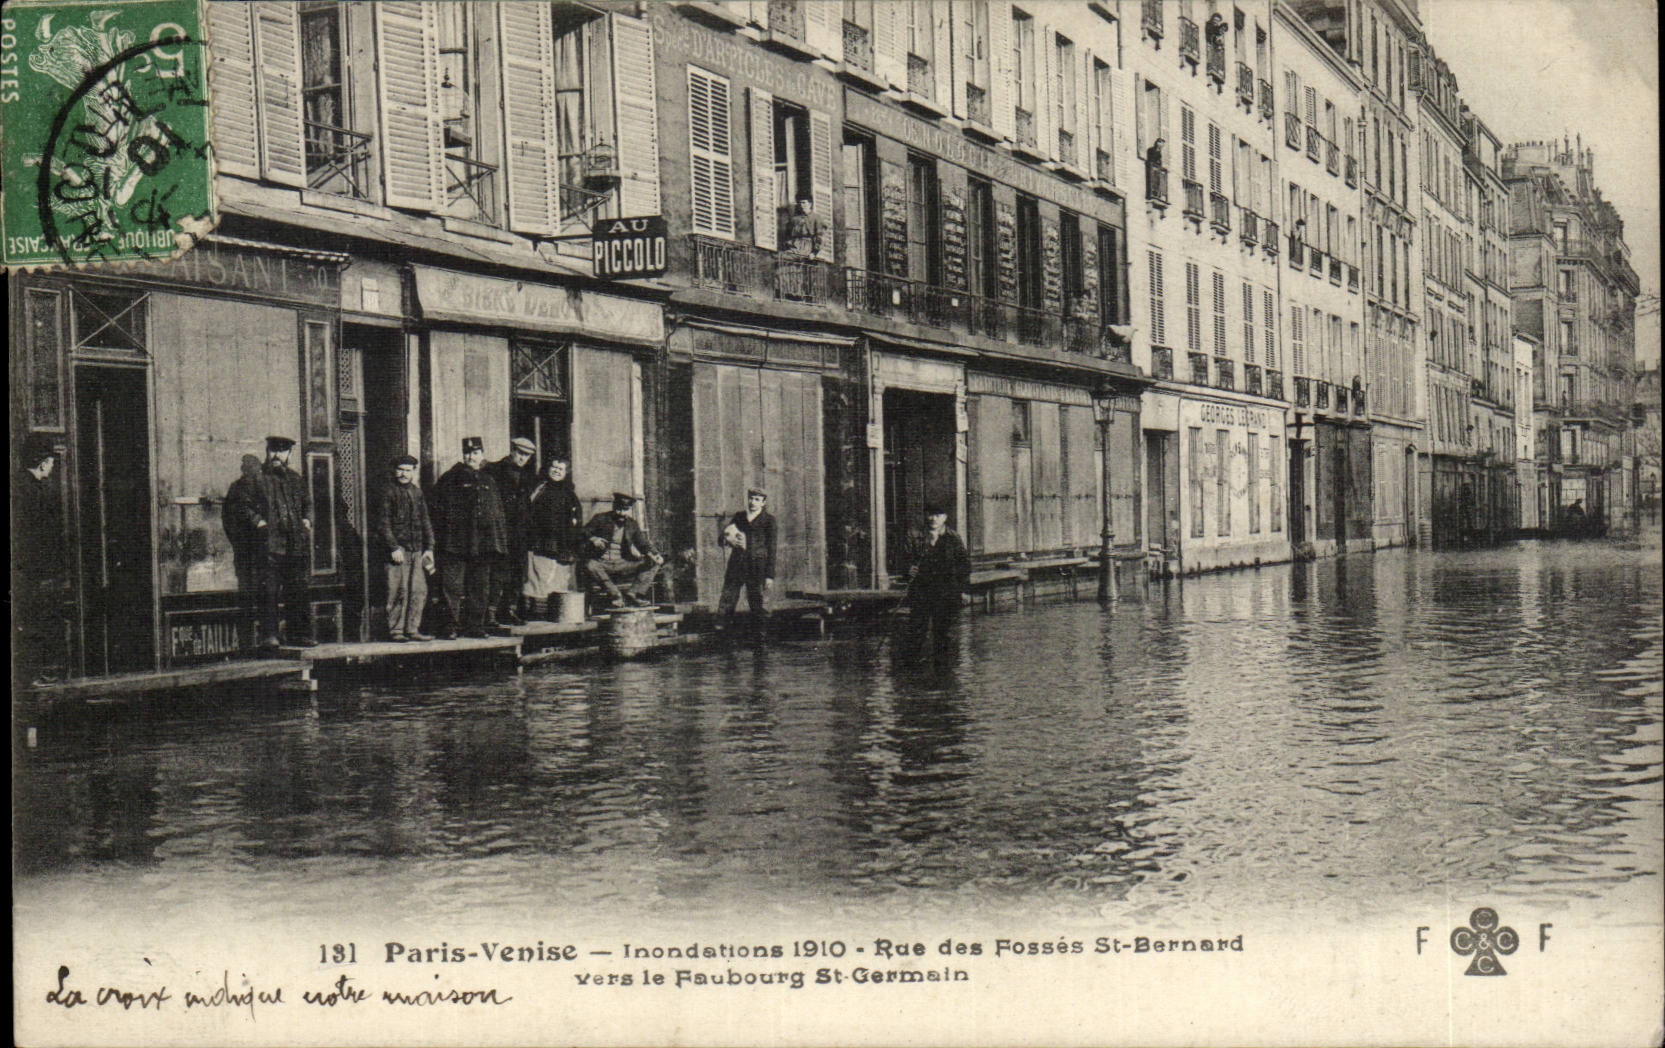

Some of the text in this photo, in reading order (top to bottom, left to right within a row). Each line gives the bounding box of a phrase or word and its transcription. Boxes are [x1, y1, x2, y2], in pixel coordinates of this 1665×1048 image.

[1, 18, 20, 103] POSTES
[691, 29, 785, 90] D'ARTICLES
[797, 73, 837, 110] CAVE
[607, 219, 649, 234] AU
[594, 236, 665, 275] PICCOLO
[1201, 403, 1235, 426] GEORGES
[46, 965, 87, 1008] La
[184, 969, 285, 1022] indique
[302, 974, 372, 1007] notre
[382, 973, 513, 1007] maison
